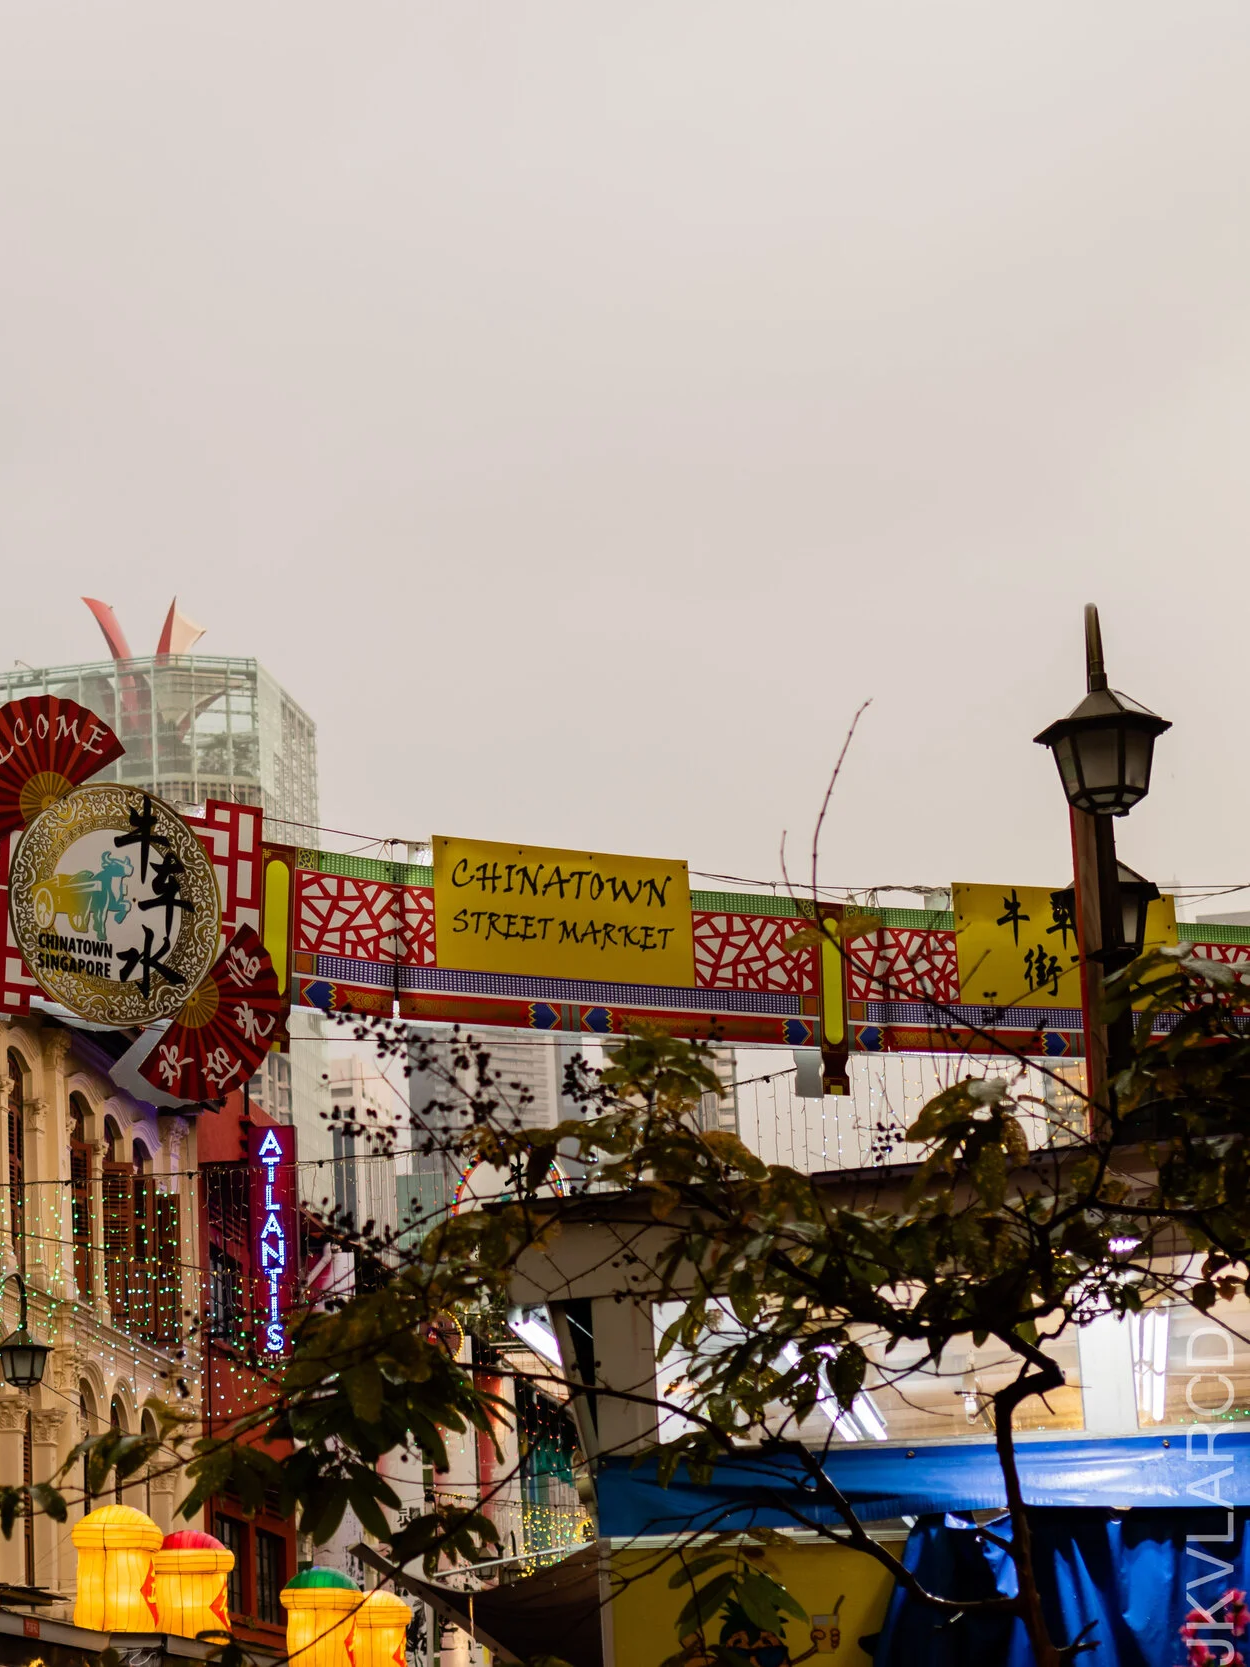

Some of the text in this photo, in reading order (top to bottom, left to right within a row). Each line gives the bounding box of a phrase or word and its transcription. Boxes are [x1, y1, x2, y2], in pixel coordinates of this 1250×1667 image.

[114, 796, 194, 1000] 牛车水
[452, 858, 672, 908] CHINATOWN
[38, 933, 113, 959] CHINATOWN
[452, 908, 675, 952] STREET MARKET
[37, 951, 112, 979] SINGAPORE
[258, 1129, 286, 1351] ATLANTIS
